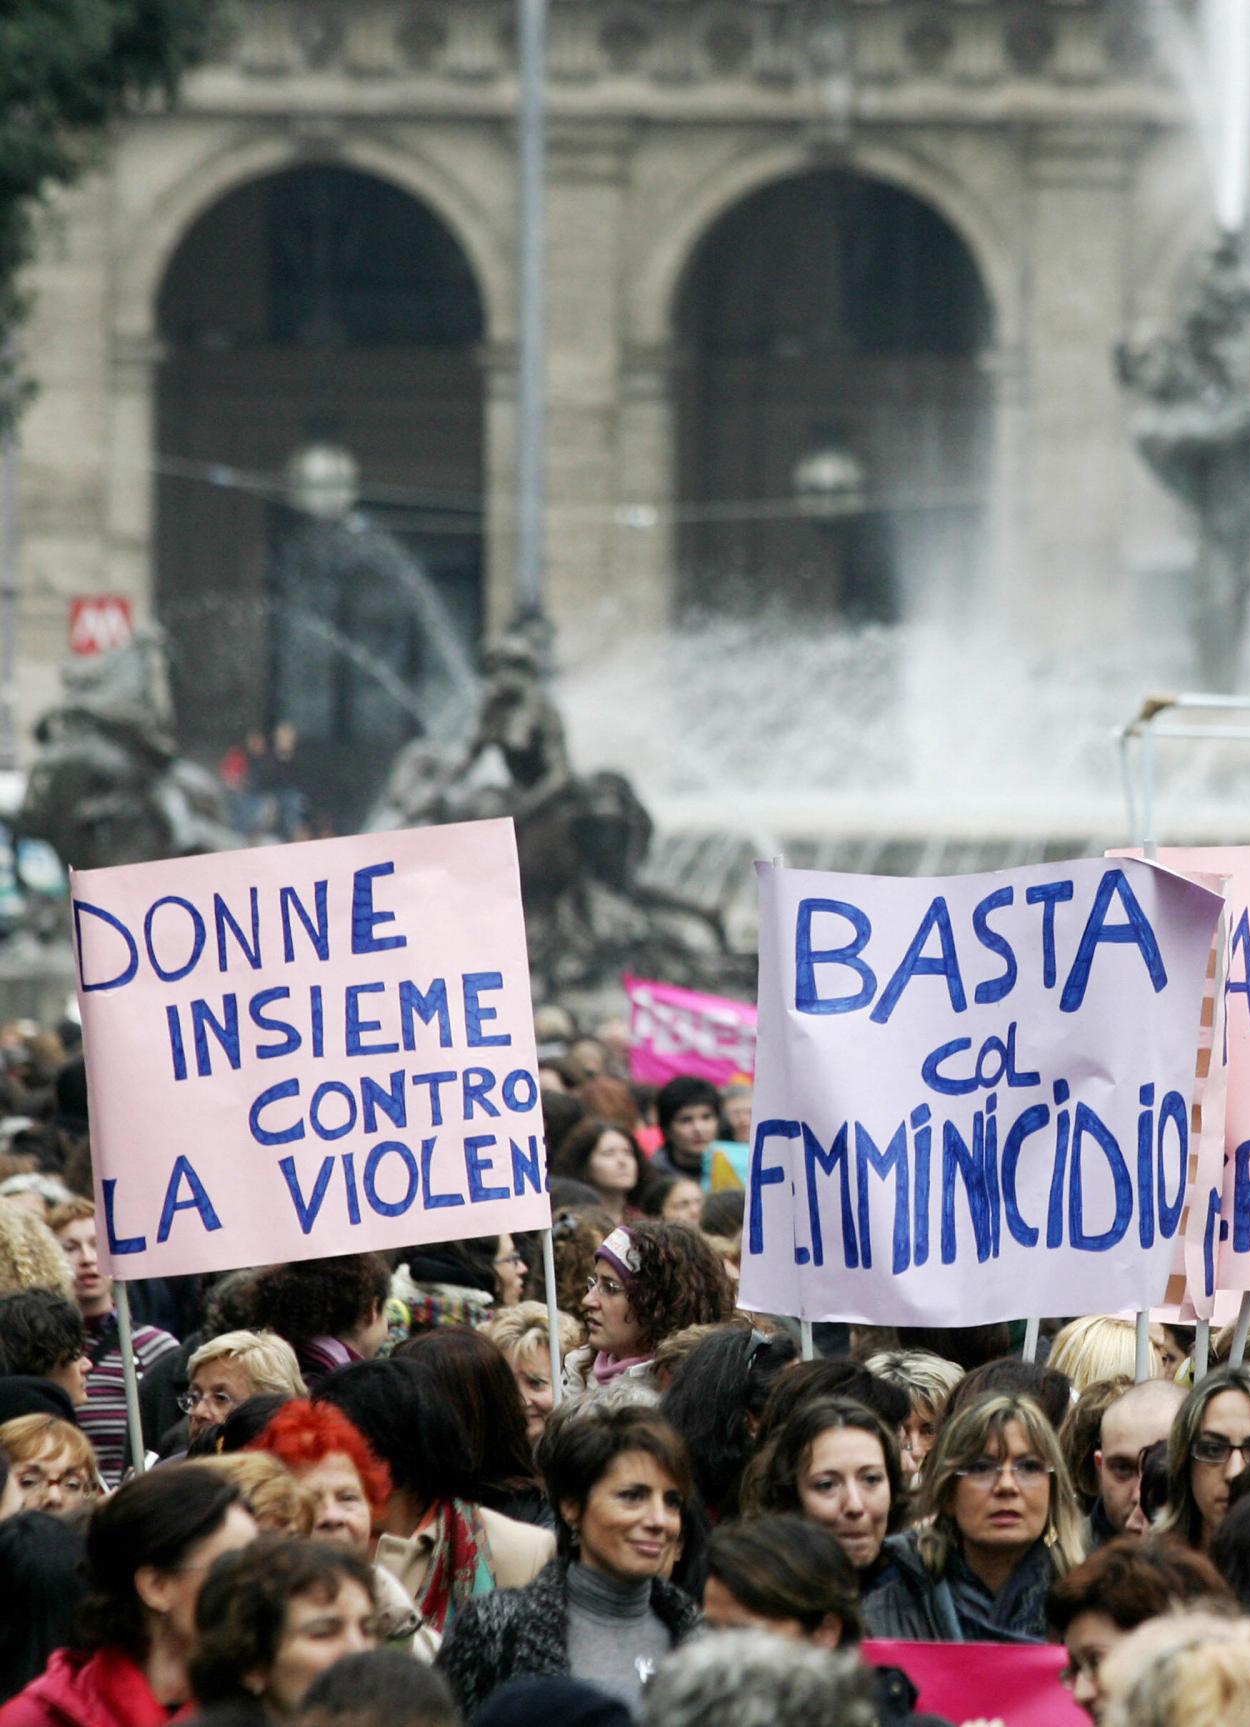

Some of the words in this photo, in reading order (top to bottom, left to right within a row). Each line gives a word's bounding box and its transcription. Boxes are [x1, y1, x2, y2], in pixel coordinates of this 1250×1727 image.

[73, 861, 408, 993] DONNE
[795, 868, 1168, 1024] BASTA
[166, 971, 512, 1081] INSIEME
[248, 1066, 538, 1146] CONTRO
[102, 1154, 223, 1256] LA
[278, 1133, 551, 1235] VIOLEN
